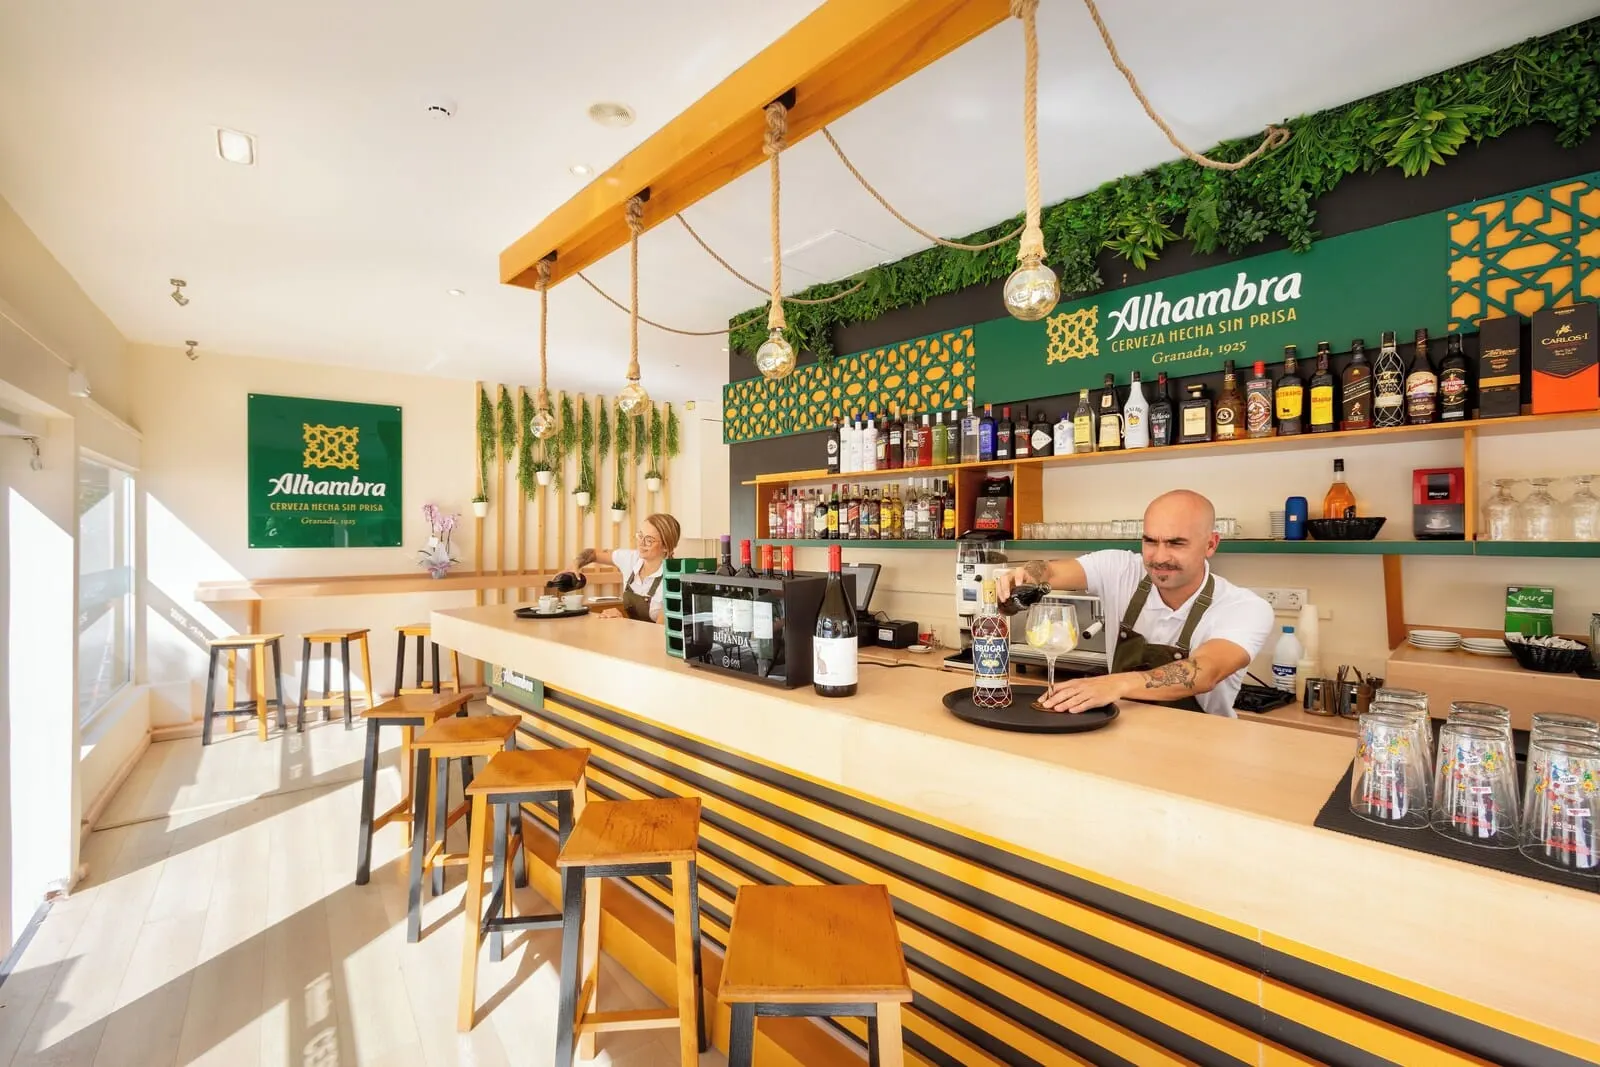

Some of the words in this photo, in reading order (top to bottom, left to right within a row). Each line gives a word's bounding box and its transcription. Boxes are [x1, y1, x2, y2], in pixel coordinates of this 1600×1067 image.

[1106, 272, 1302, 341] Alhambra
[1111, 332, 1166, 353] CERVEZA
[1169, 323, 1214, 343] HECHA
[1219, 317, 1244, 334] SIN
[1250, 307, 1297, 328] PRISA
[1152, 346, 1214, 365] Granada,
[1218, 341, 1247, 354] 1925
[267, 473, 386, 497] Alhambra
[270, 503, 310, 511] CERVEZA
[359, 504, 384, 512] PRISA
